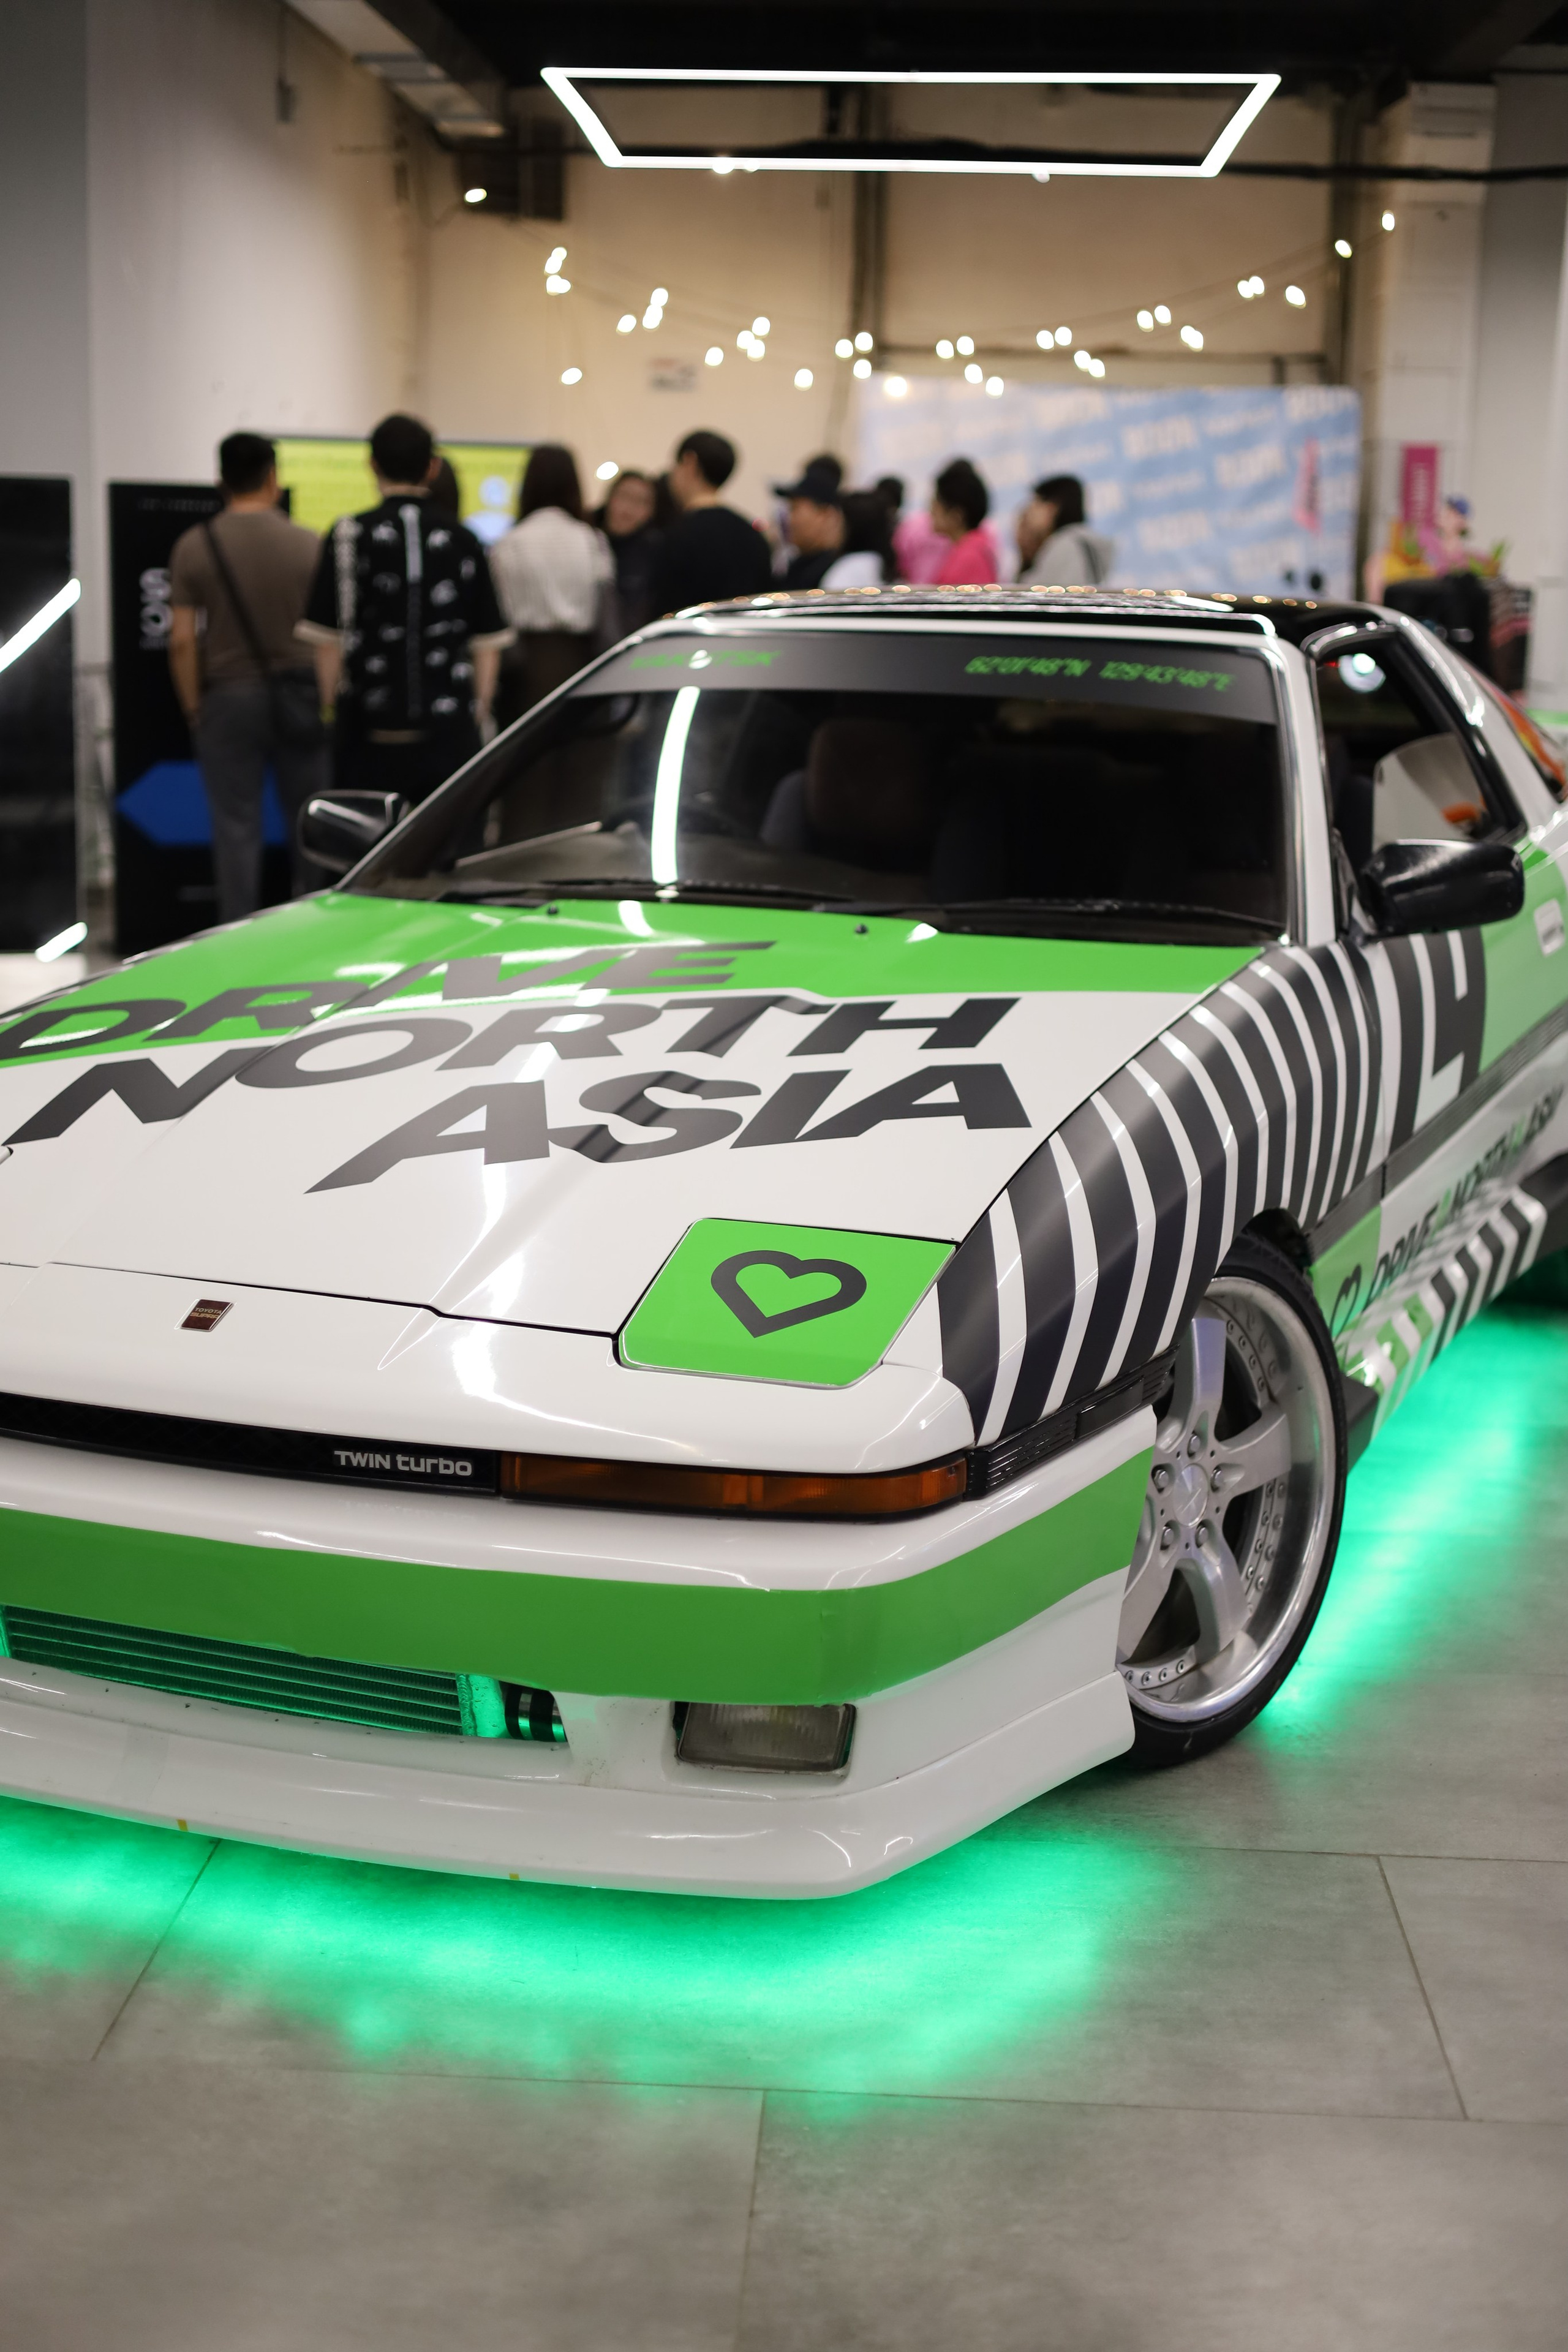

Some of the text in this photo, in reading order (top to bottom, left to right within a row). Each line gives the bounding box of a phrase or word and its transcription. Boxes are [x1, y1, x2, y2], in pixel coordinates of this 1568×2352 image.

[0, 941, 777, 1060] DRIVE
[1, 995, 1022, 1146] NORTH
[303, 1063, 1033, 1194] ASIA
[334, 1450, 472, 1477] TWIN turbo
